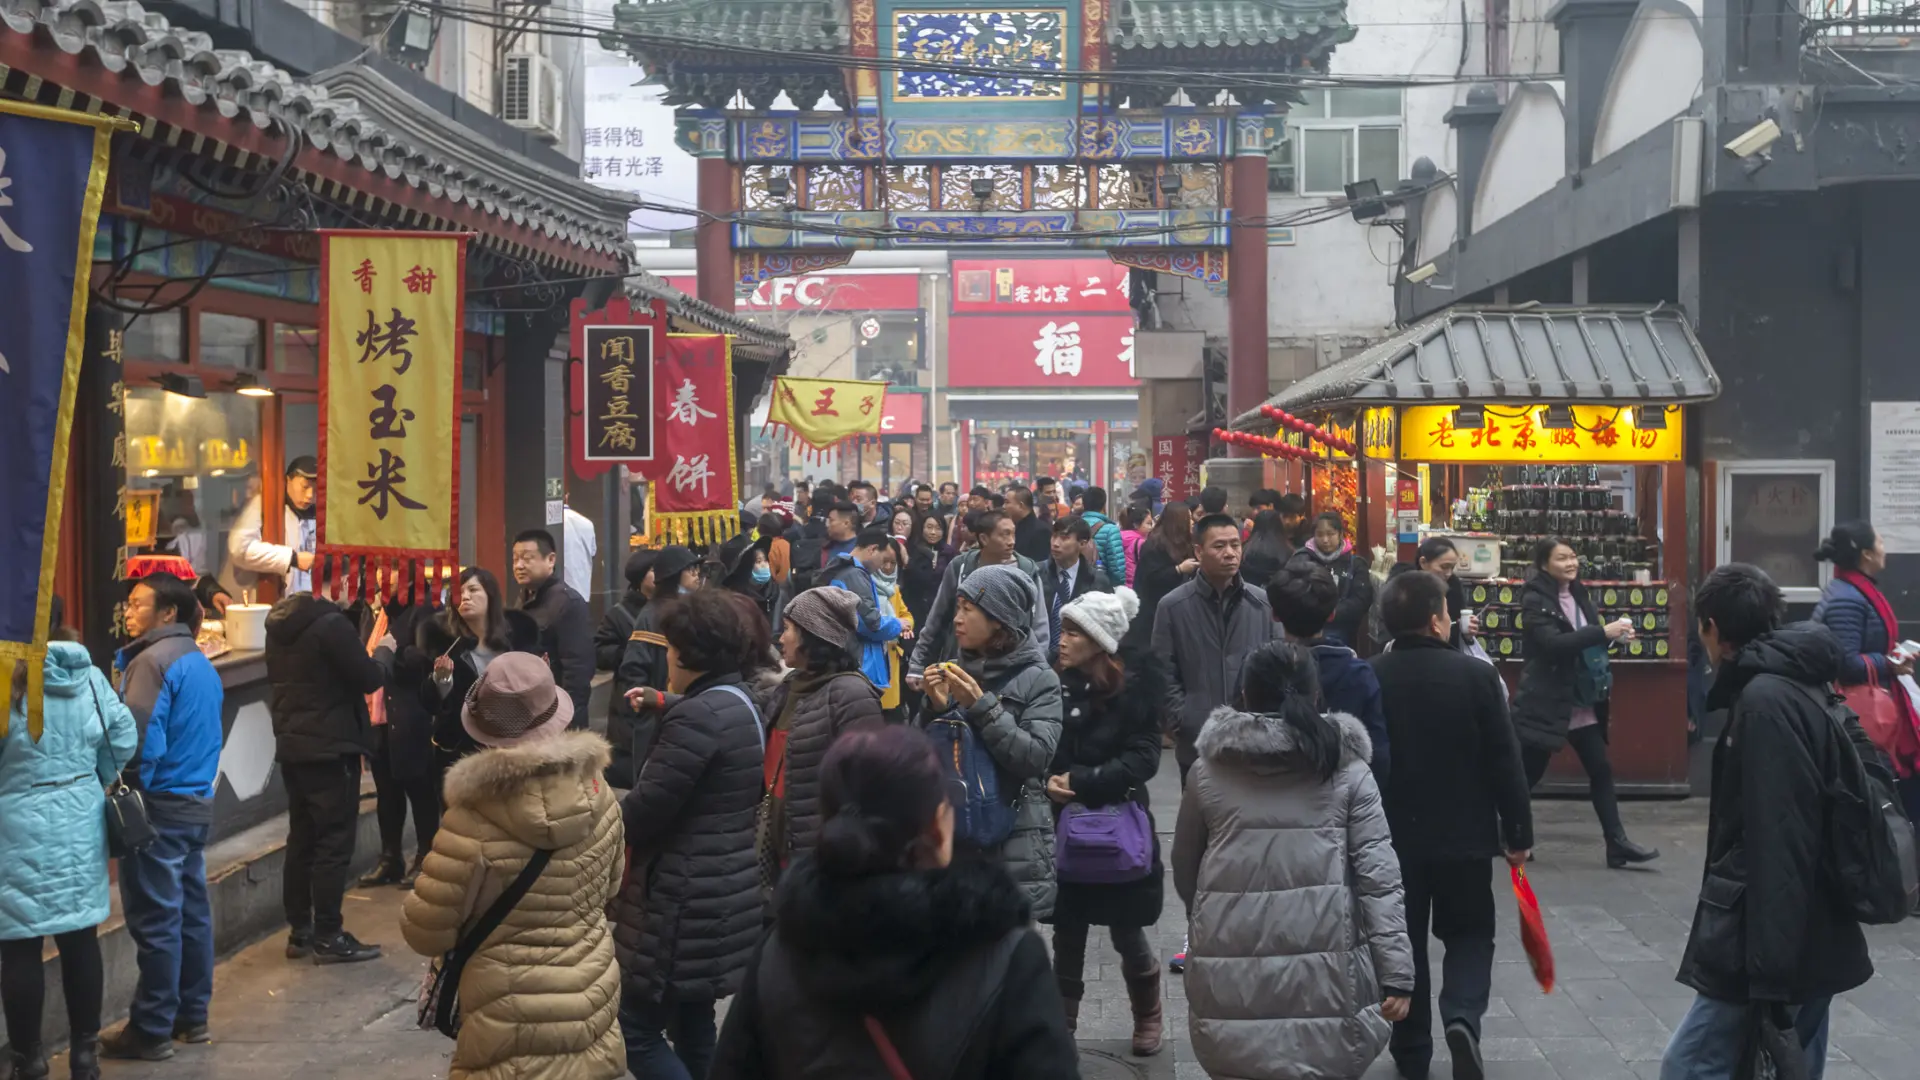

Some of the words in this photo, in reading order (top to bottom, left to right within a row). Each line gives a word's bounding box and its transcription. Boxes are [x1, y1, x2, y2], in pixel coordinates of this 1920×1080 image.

[584, 127, 643, 147] 睡得饱
[1015, 285, 1071, 303] 老北京
[356, 308, 428, 520] 烤玉米
[1429, 415, 1659, 451] 老北京酸梅汤
